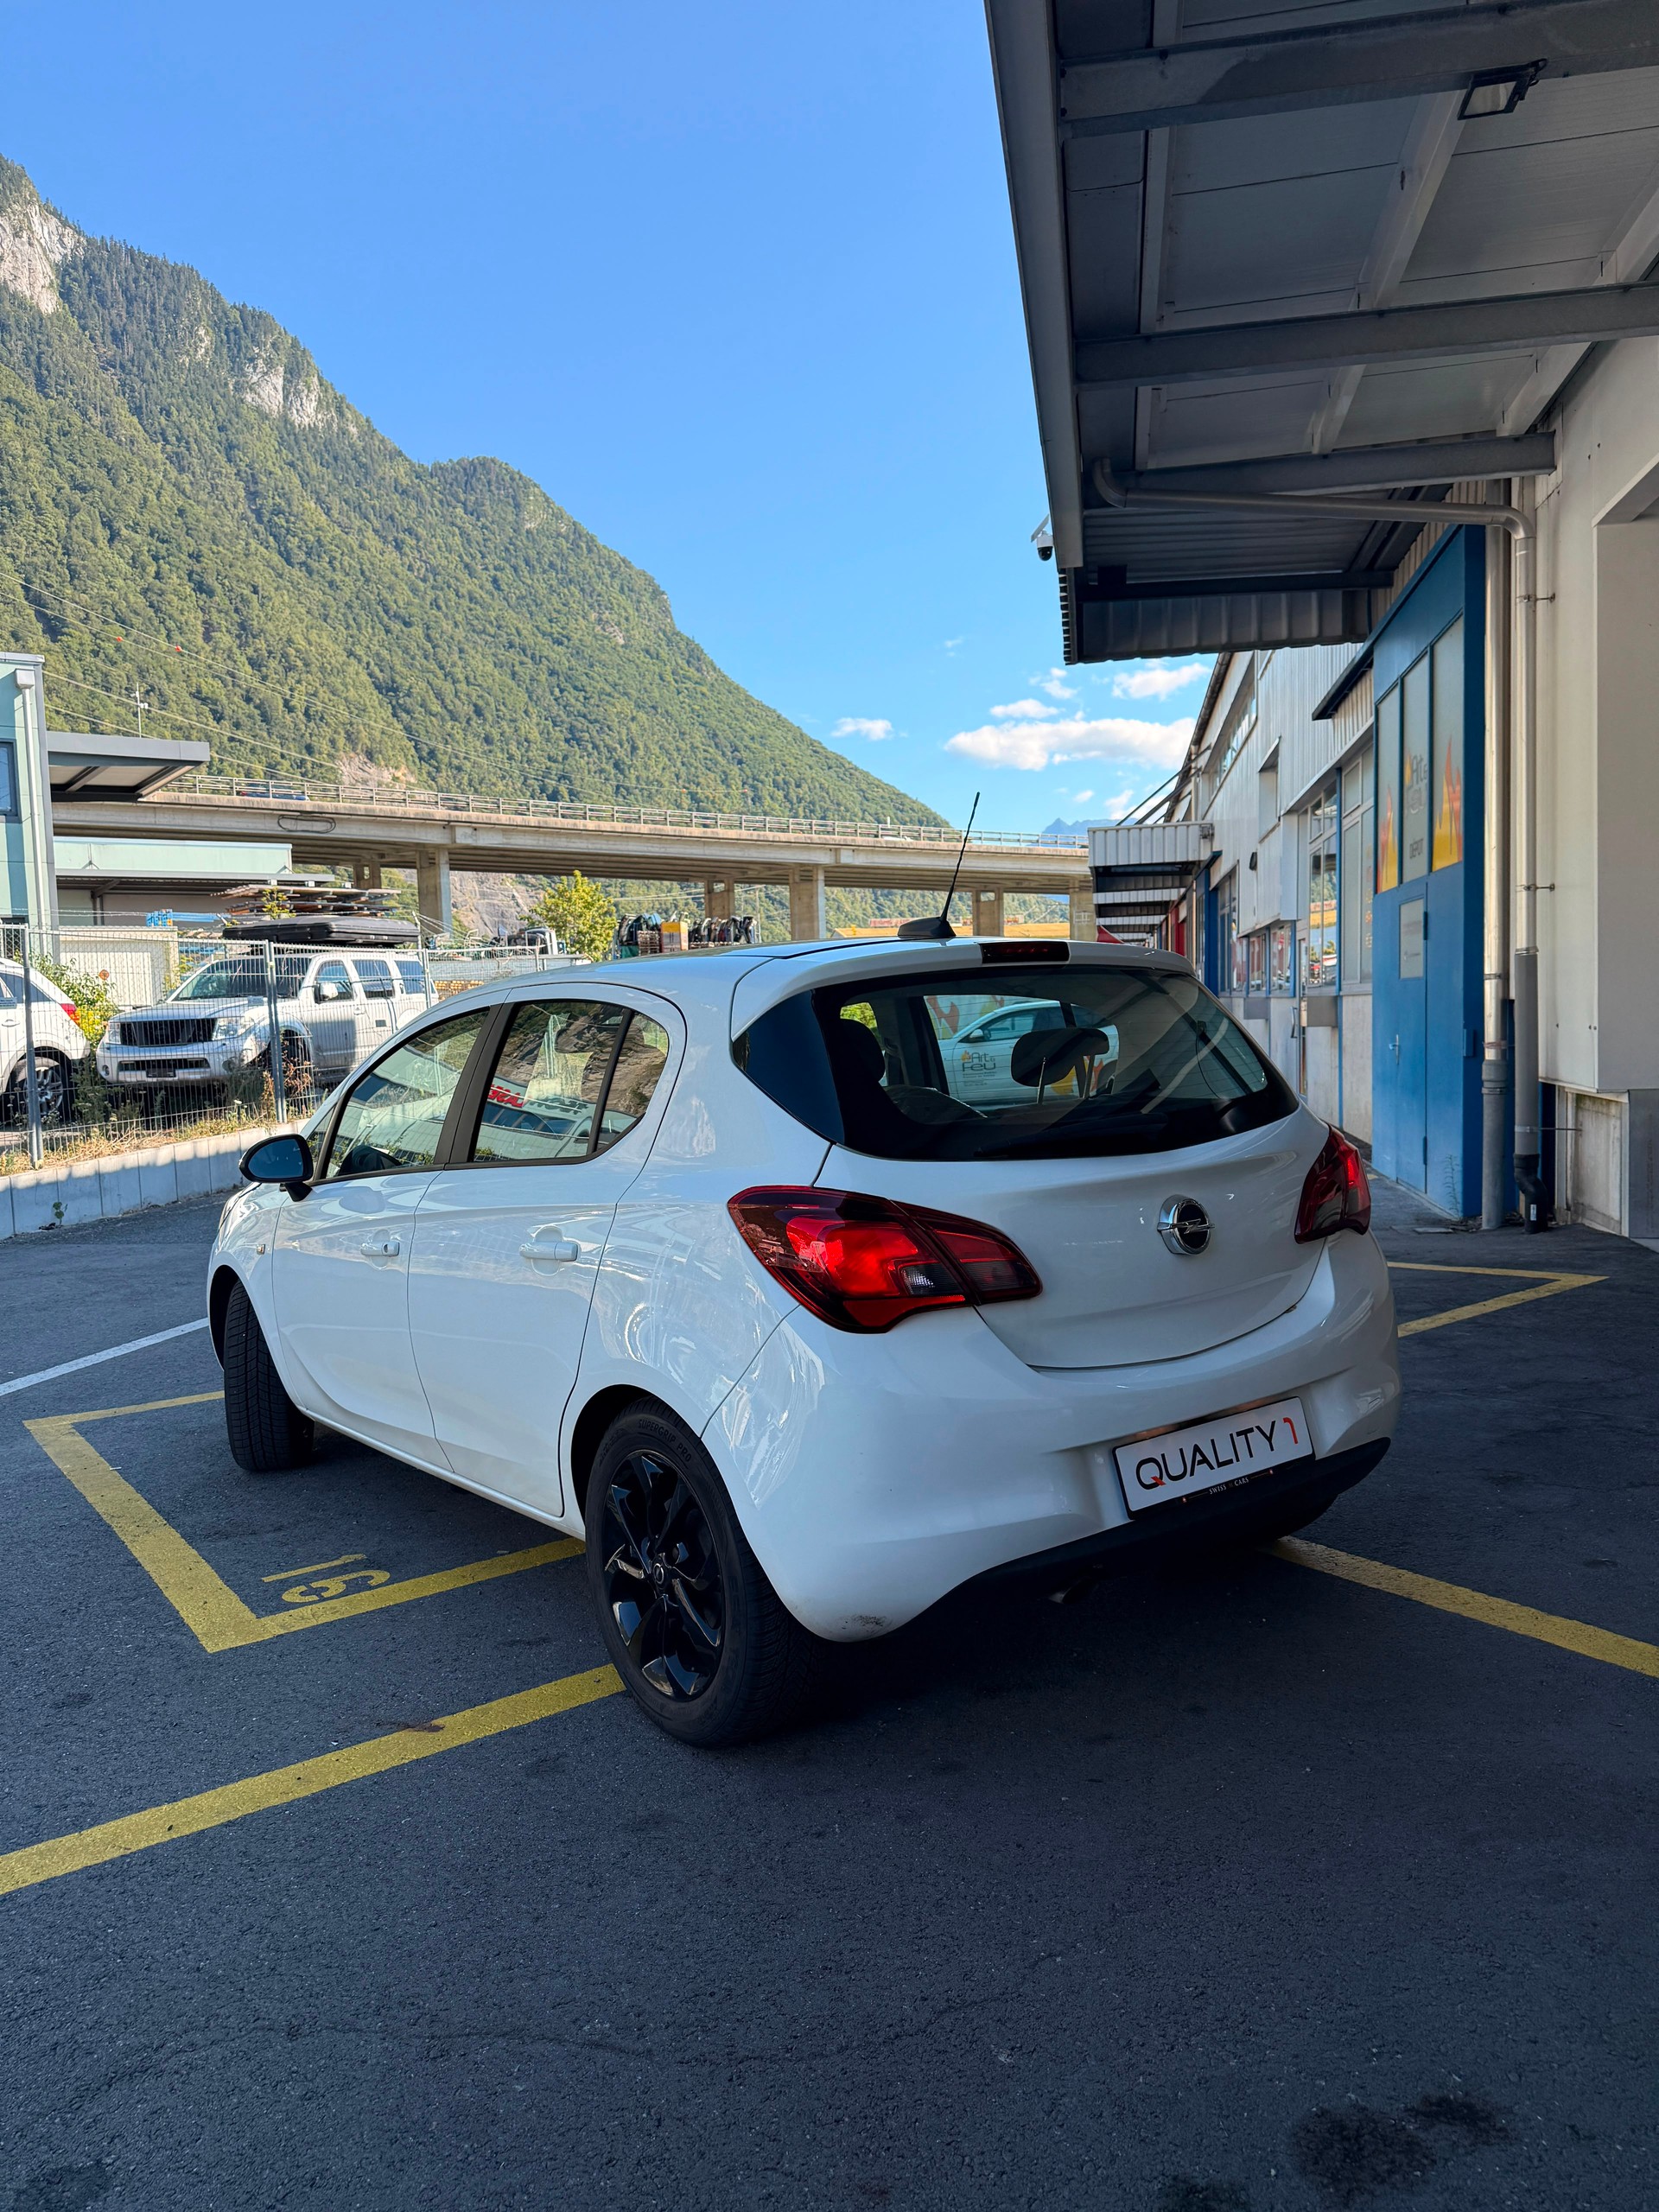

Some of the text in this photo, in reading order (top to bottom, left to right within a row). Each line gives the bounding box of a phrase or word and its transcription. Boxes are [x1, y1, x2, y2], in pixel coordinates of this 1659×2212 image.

[962, 1061, 996, 1072] Feu
[971, 1052, 989, 1063] Art
[638, 1419, 692, 1462] SUPERGRIP PRO
[1135, 1417, 1299, 1491] QUALITY 1
[1209, 1477, 1249, 1495] SWISS CARS
